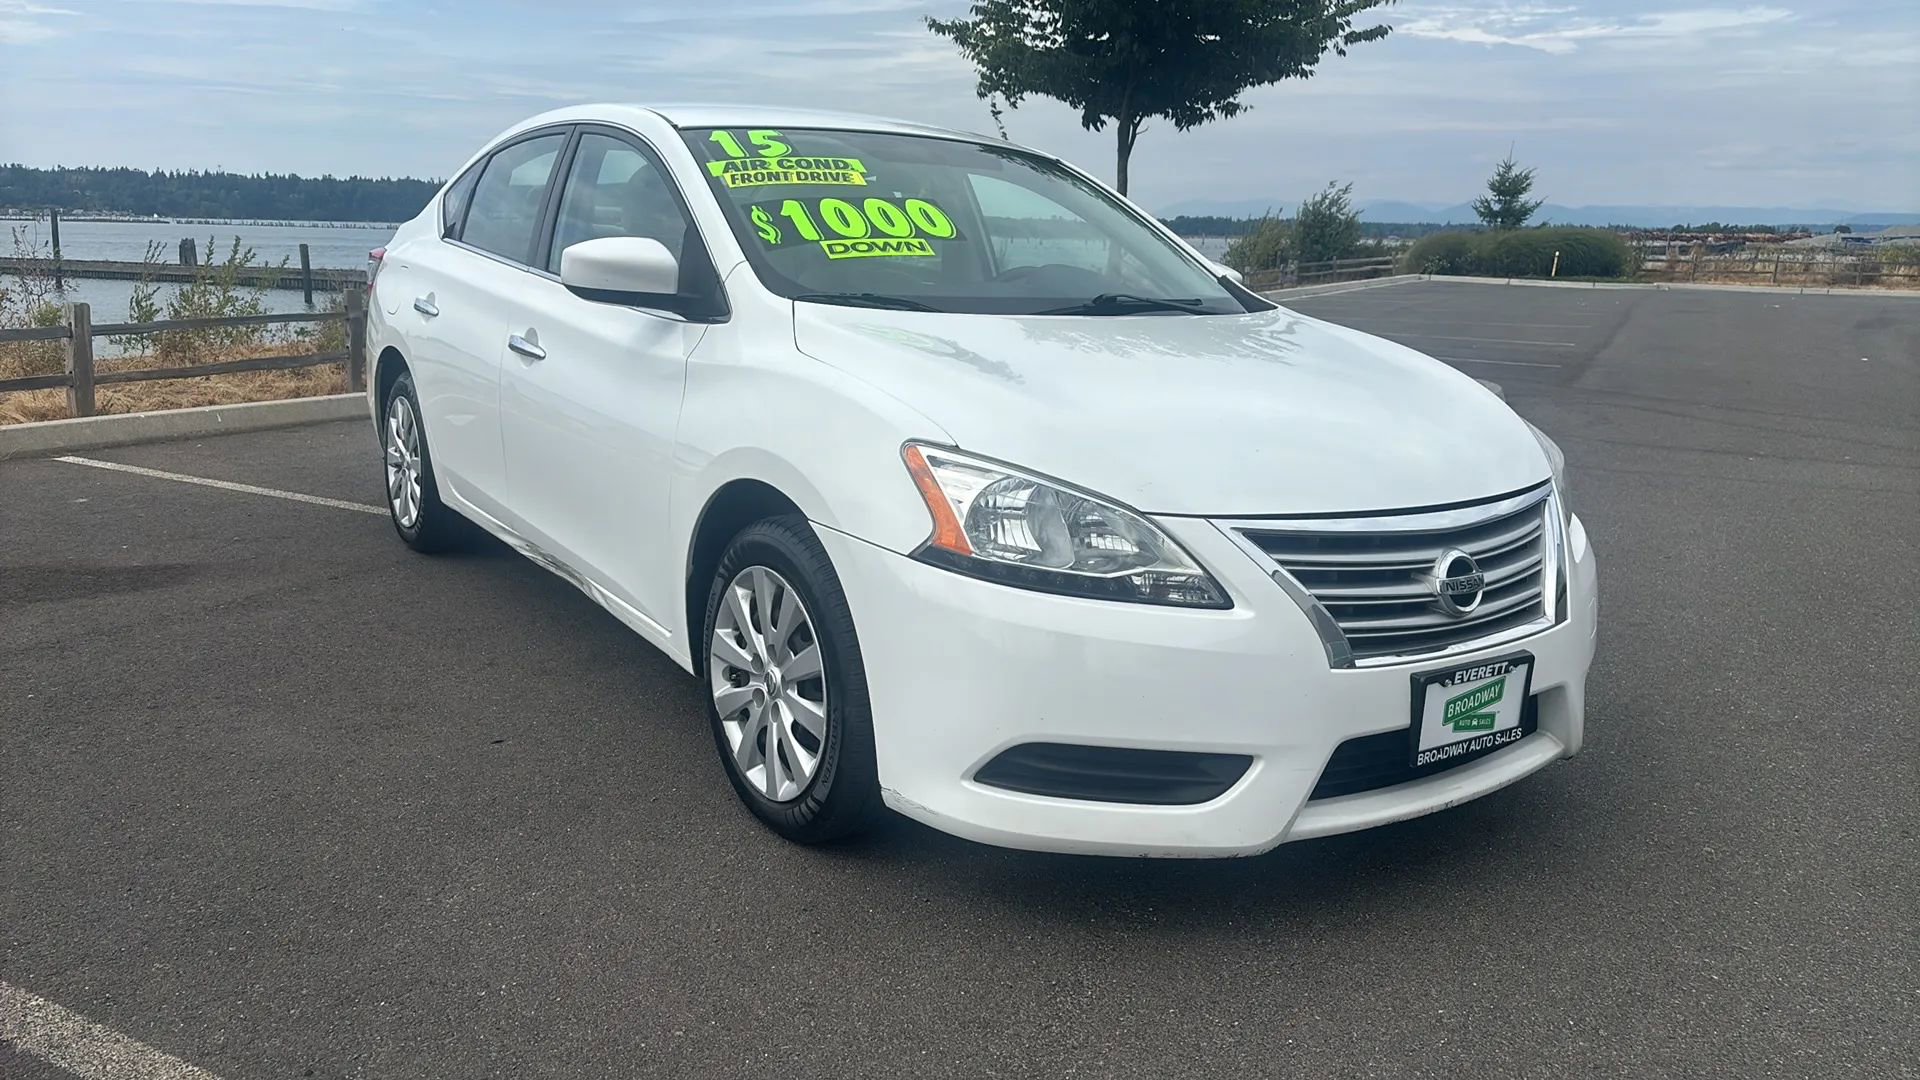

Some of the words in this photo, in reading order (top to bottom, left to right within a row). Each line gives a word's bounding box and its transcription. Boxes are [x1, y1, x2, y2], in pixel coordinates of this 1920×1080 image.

[709, 130, 792, 158] 15
[722, 159, 772, 173] AIR
[776, 158, 855, 171] COND.
[730, 172, 790, 185] FRONT
[795, 172, 853, 184] DRIVE
[751, 198, 957, 244] $1000
[826, 241, 928, 255] DOWN
[1454, 662, 1508, 684] EVERETT
[1447, 683, 1502, 718] BROADWAY
[1417, 741, 1469, 766] BROADWAY
[1469, 735, 1493, 752] AUTO
[1494, 728, 1523, 745] SALES
